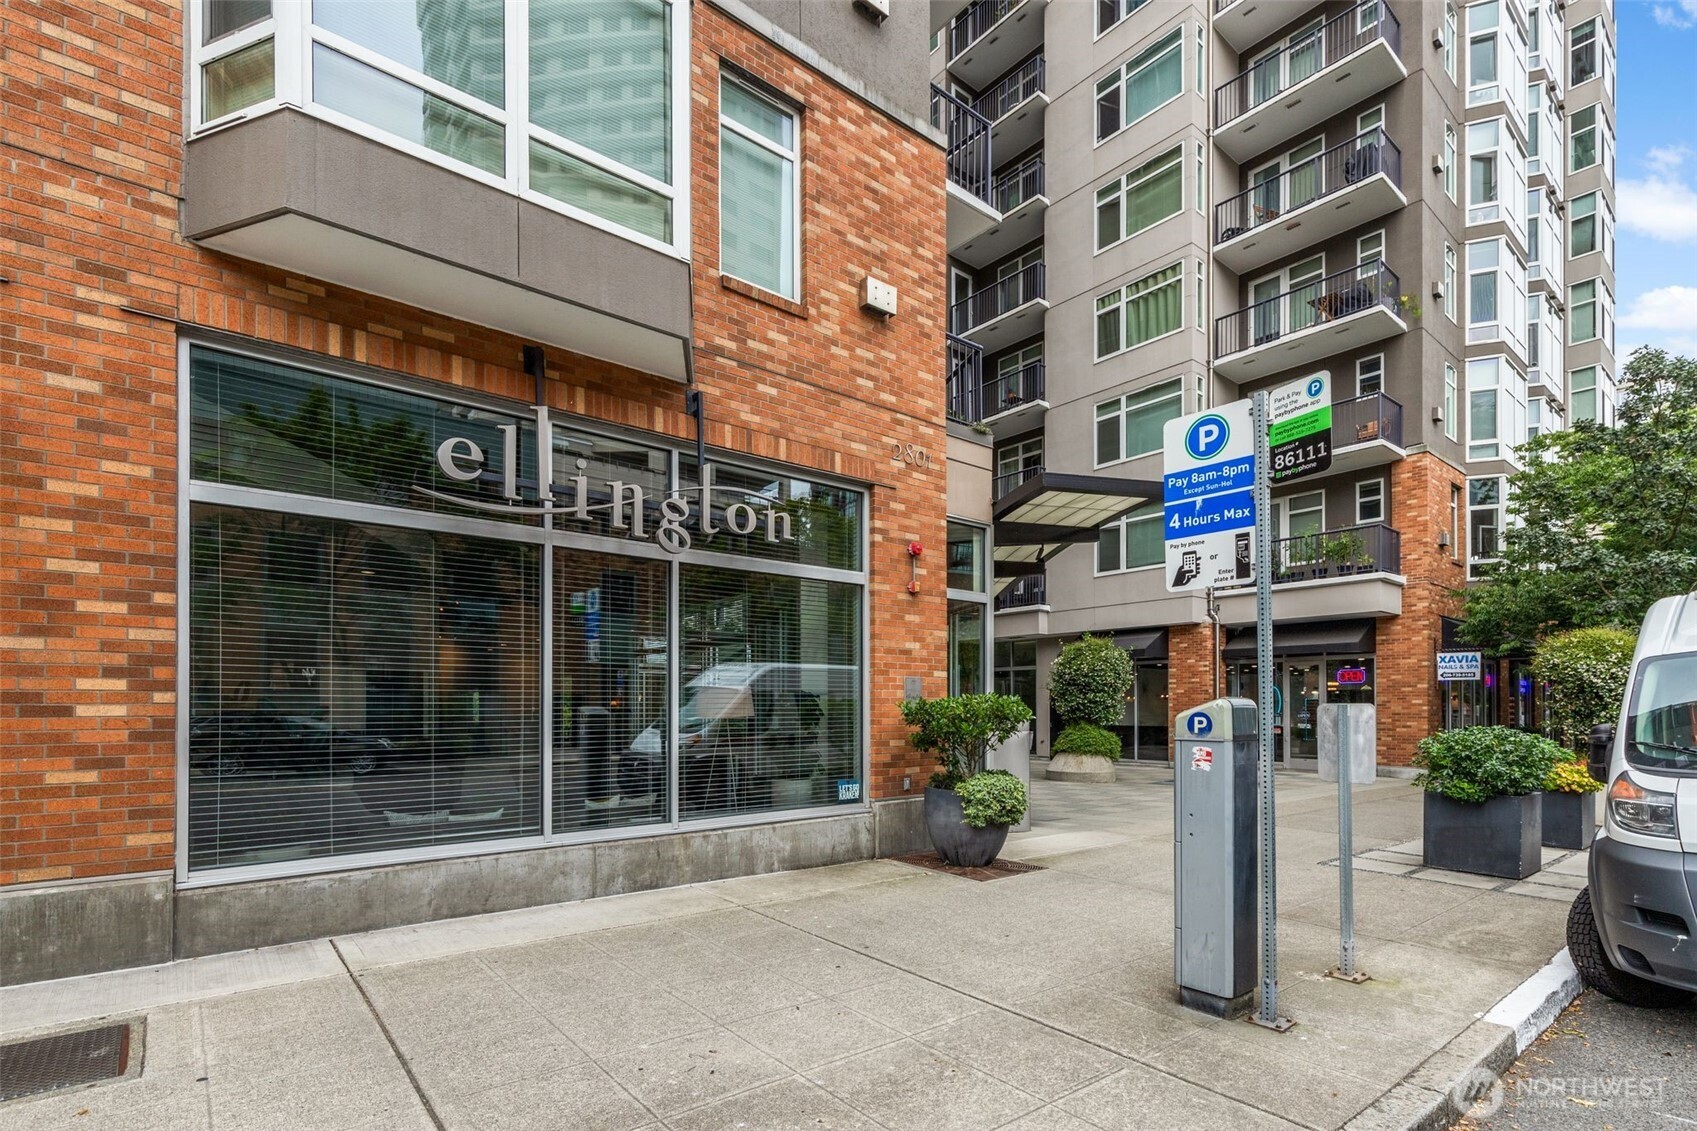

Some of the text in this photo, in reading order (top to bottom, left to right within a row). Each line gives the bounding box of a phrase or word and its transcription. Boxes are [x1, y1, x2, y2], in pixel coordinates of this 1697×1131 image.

[1312, 382, 1320, 394] P
[1274, 396, 1285, 404] Park
[1274, 403, 1289, 411] using
[1275, 398, 1321, 419] paybyphone app
[1199, 424, 1219, 451] P
[891, 442, 932, 469] 2801
[1275, 444, 1295, 453] Location
[1275, 442, 1328, 470] 86111
[1168, 463, 1250, 489] Pay 8am-8pm
[1282, 462, 1317, 477] paybyphone
[435, 405, 796, 554] ellington
[1184, 480, 1233, 495] Except Sun-Hol
[1169, 507, 1250, 529] 4 Hours Max
[1188, 540, 1205, 548] phone
[1438, 654, 1479, 664] XAVIA
[1339, 671, 1363, 681] OPEN
[1193, 716, 1208, 734] P
